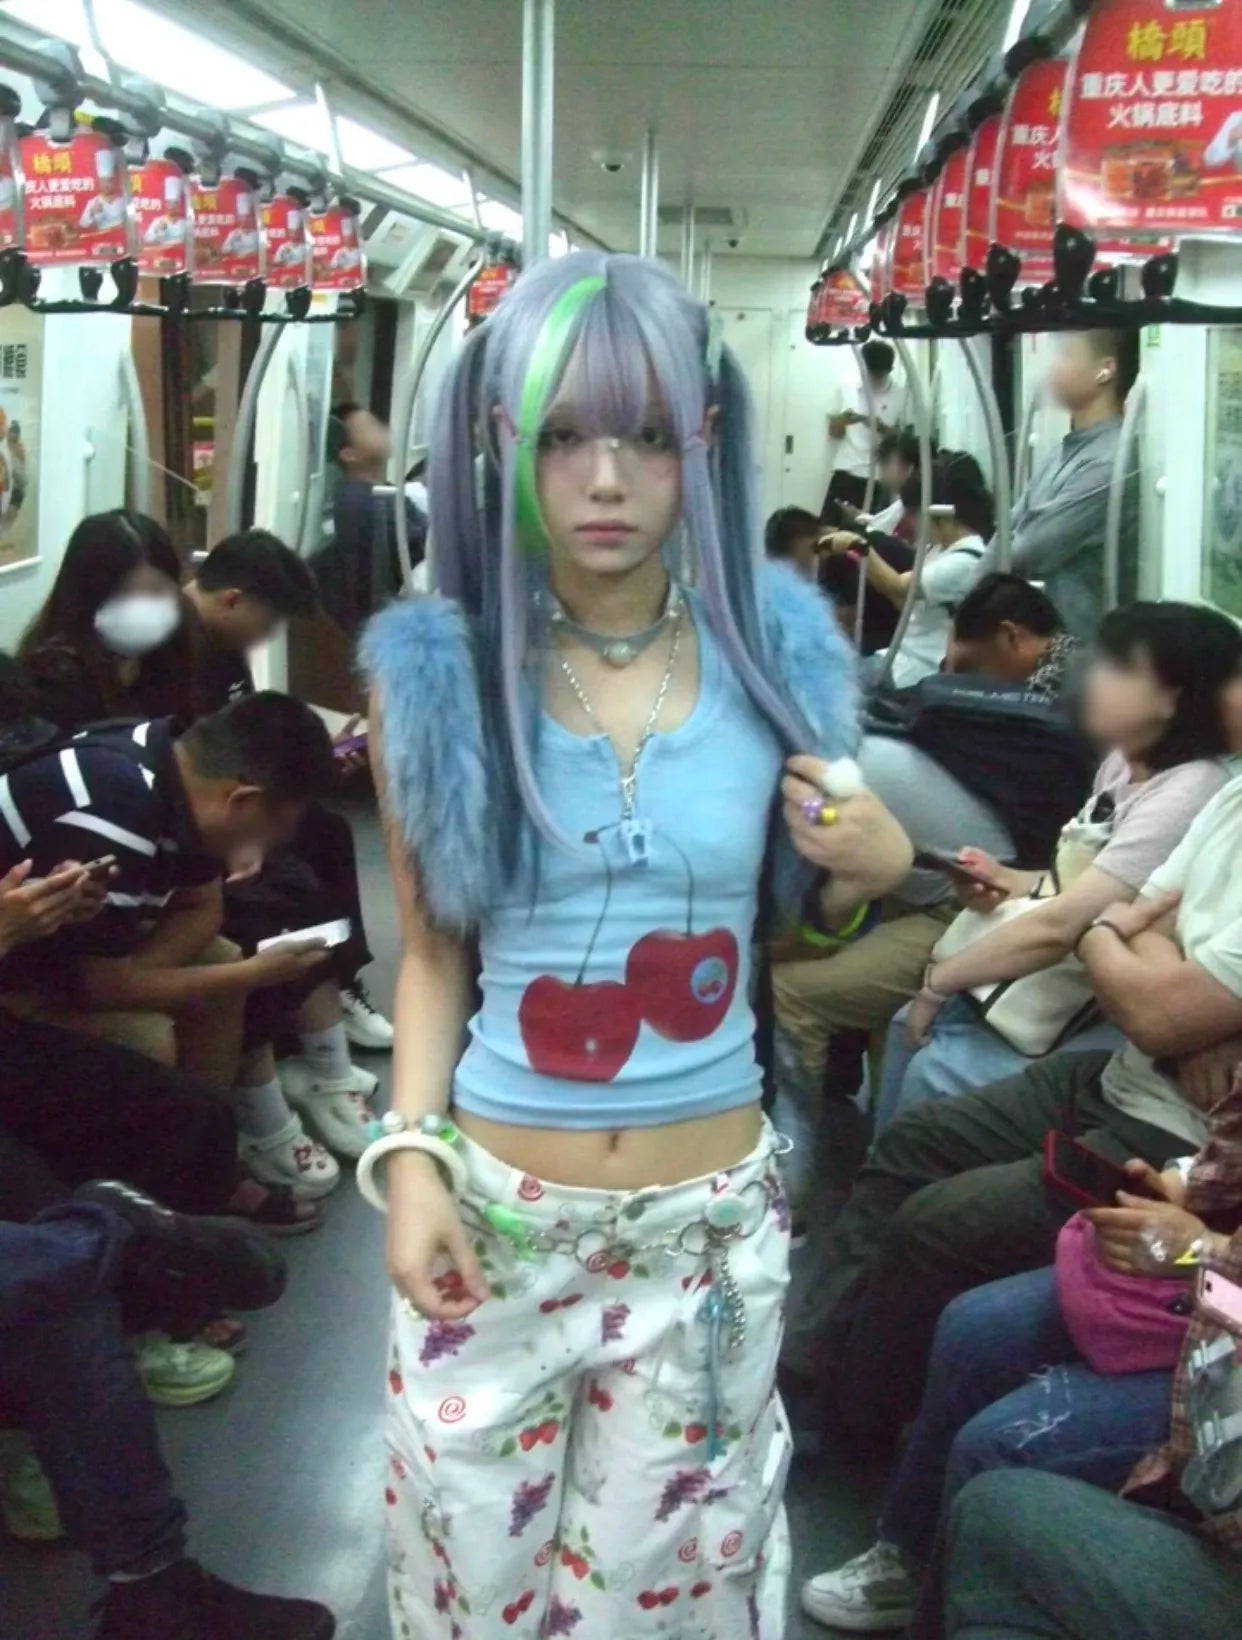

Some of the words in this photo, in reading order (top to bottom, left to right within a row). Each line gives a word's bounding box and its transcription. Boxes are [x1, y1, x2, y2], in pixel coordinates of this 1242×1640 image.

[1080, 69, 1242, 99] 重庆人更爱吃的
[1107, 102, 1204, 129] 火锅底料
